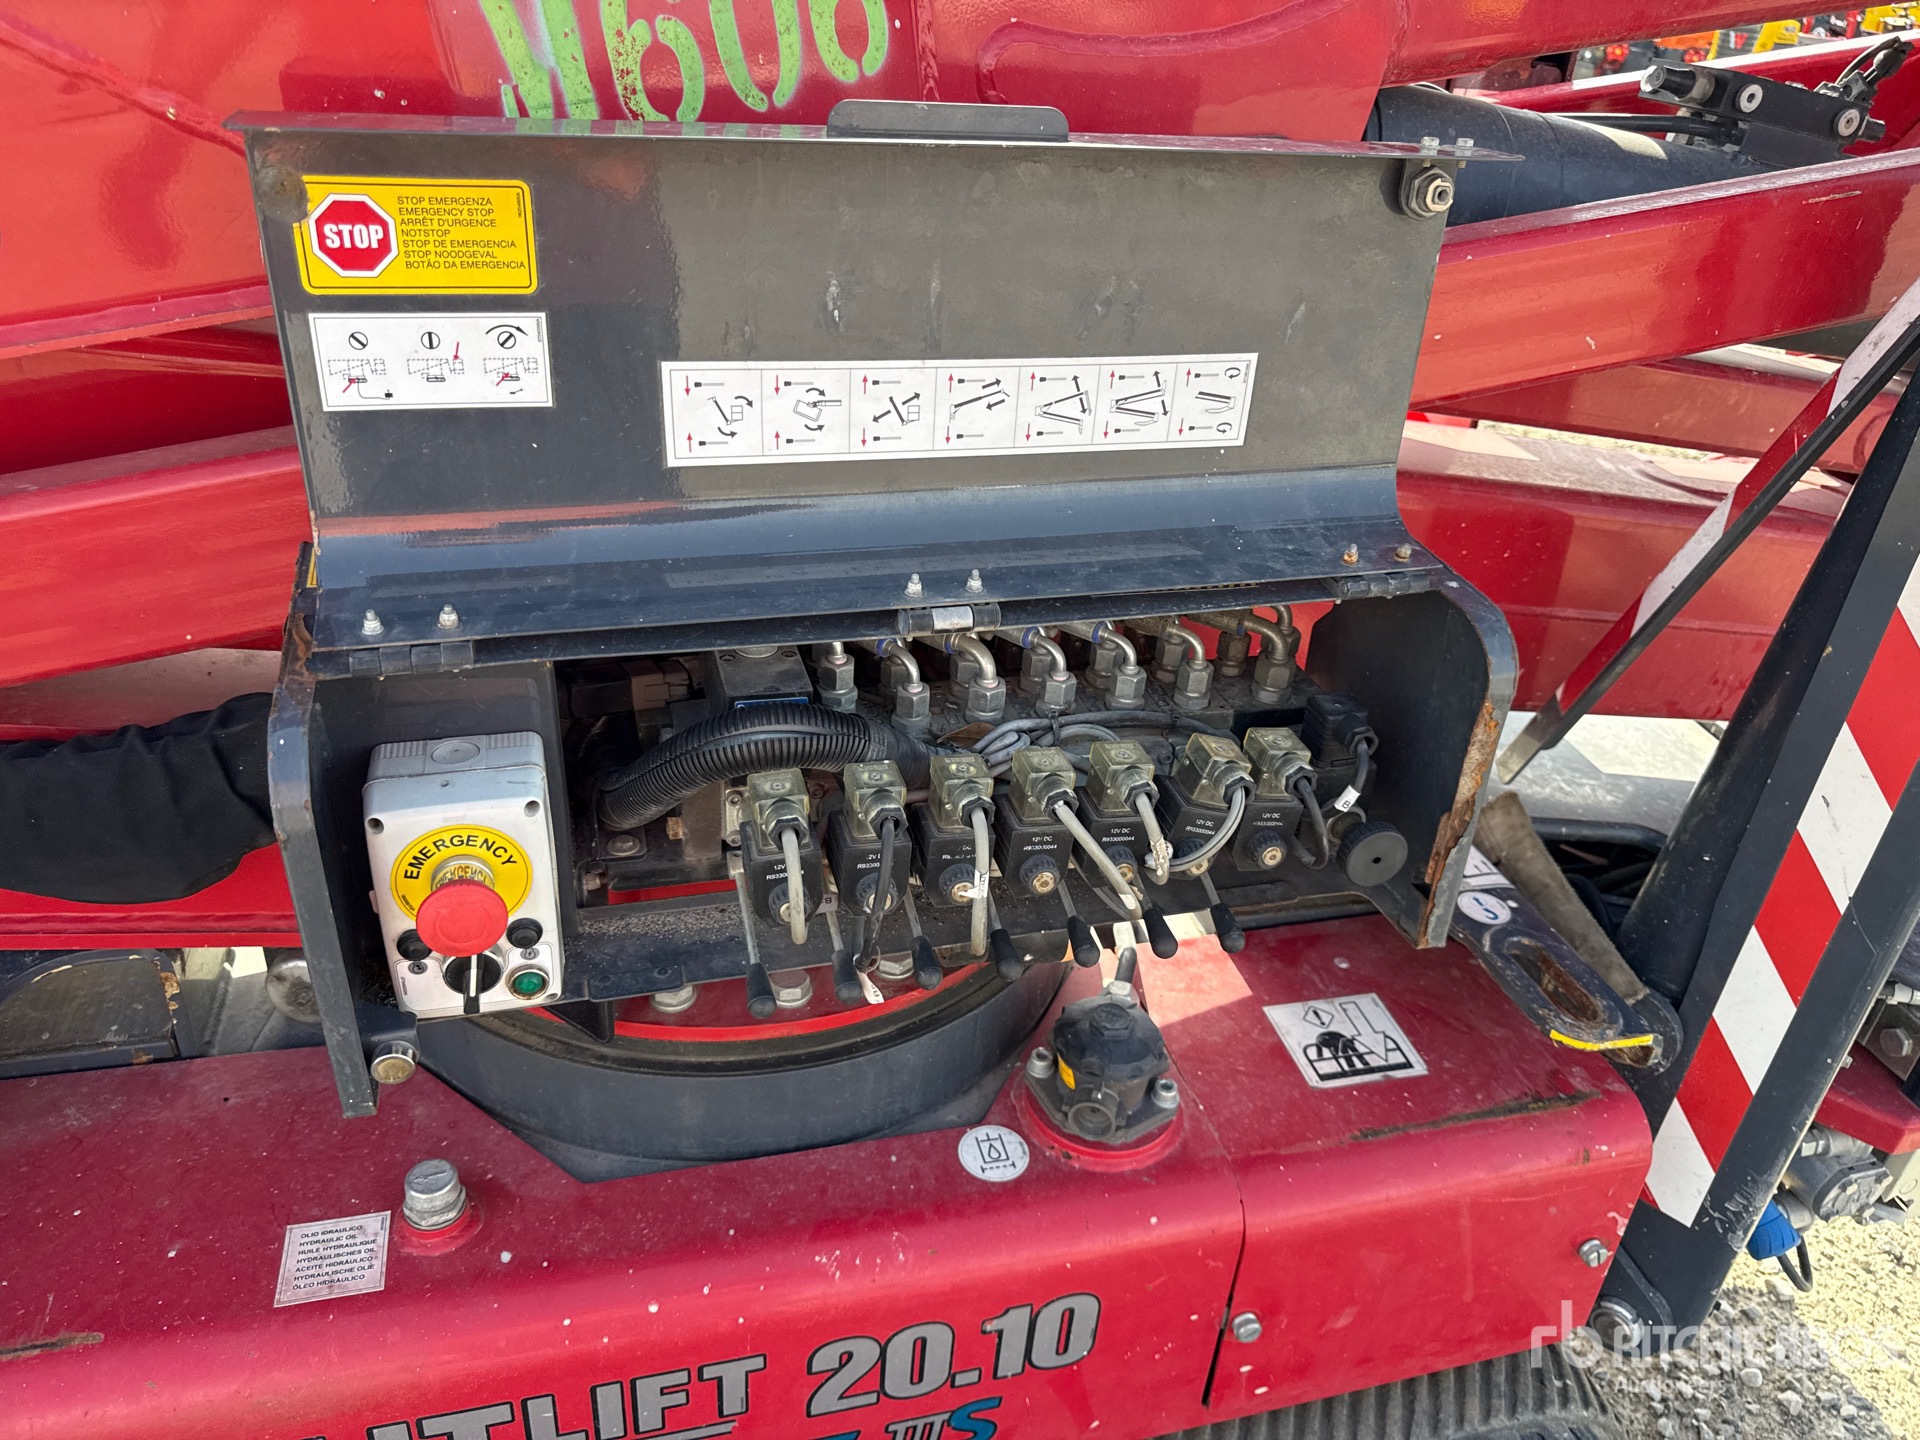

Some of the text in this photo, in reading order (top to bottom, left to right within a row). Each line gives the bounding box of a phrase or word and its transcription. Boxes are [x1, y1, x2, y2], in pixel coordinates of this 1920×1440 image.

[397, 195, 493, 206] STOP EMERGENZA
[398, 207, 495, 217] EMERGENCY STOP
[400, 215, 497, 228] ARRÊT D'URGENCE
[323, 223, 384, 249] STOP
[401, 228, 451, 238] NOTSTOP
[402, 239, 517, 249] STOP DE EMERGENCIA
[404, 250, 498, 259] STOP NOODGEVAL
[443, 260, 458, 269] DA
[460, 260, 526, 269] EMERGENCIA
[403, 834, 518, 880] EMERGENCY
[300, 1224, 363, 1239] OLIO IDRAULICO
[299, 1233, 358, 1247] HYDRAULIC OIL
[298, 1239, 378, 1256] HUILE HYDRAULIQUE
[296, 1249, 362, 1265] HYDRAULISCHES
[293, 1263, 375, 1282] HYDRAULISCHE OLIE
[295, 1263, 323, 1273] ACEITE
[807, 1292, 1102, 1419] 20.10
